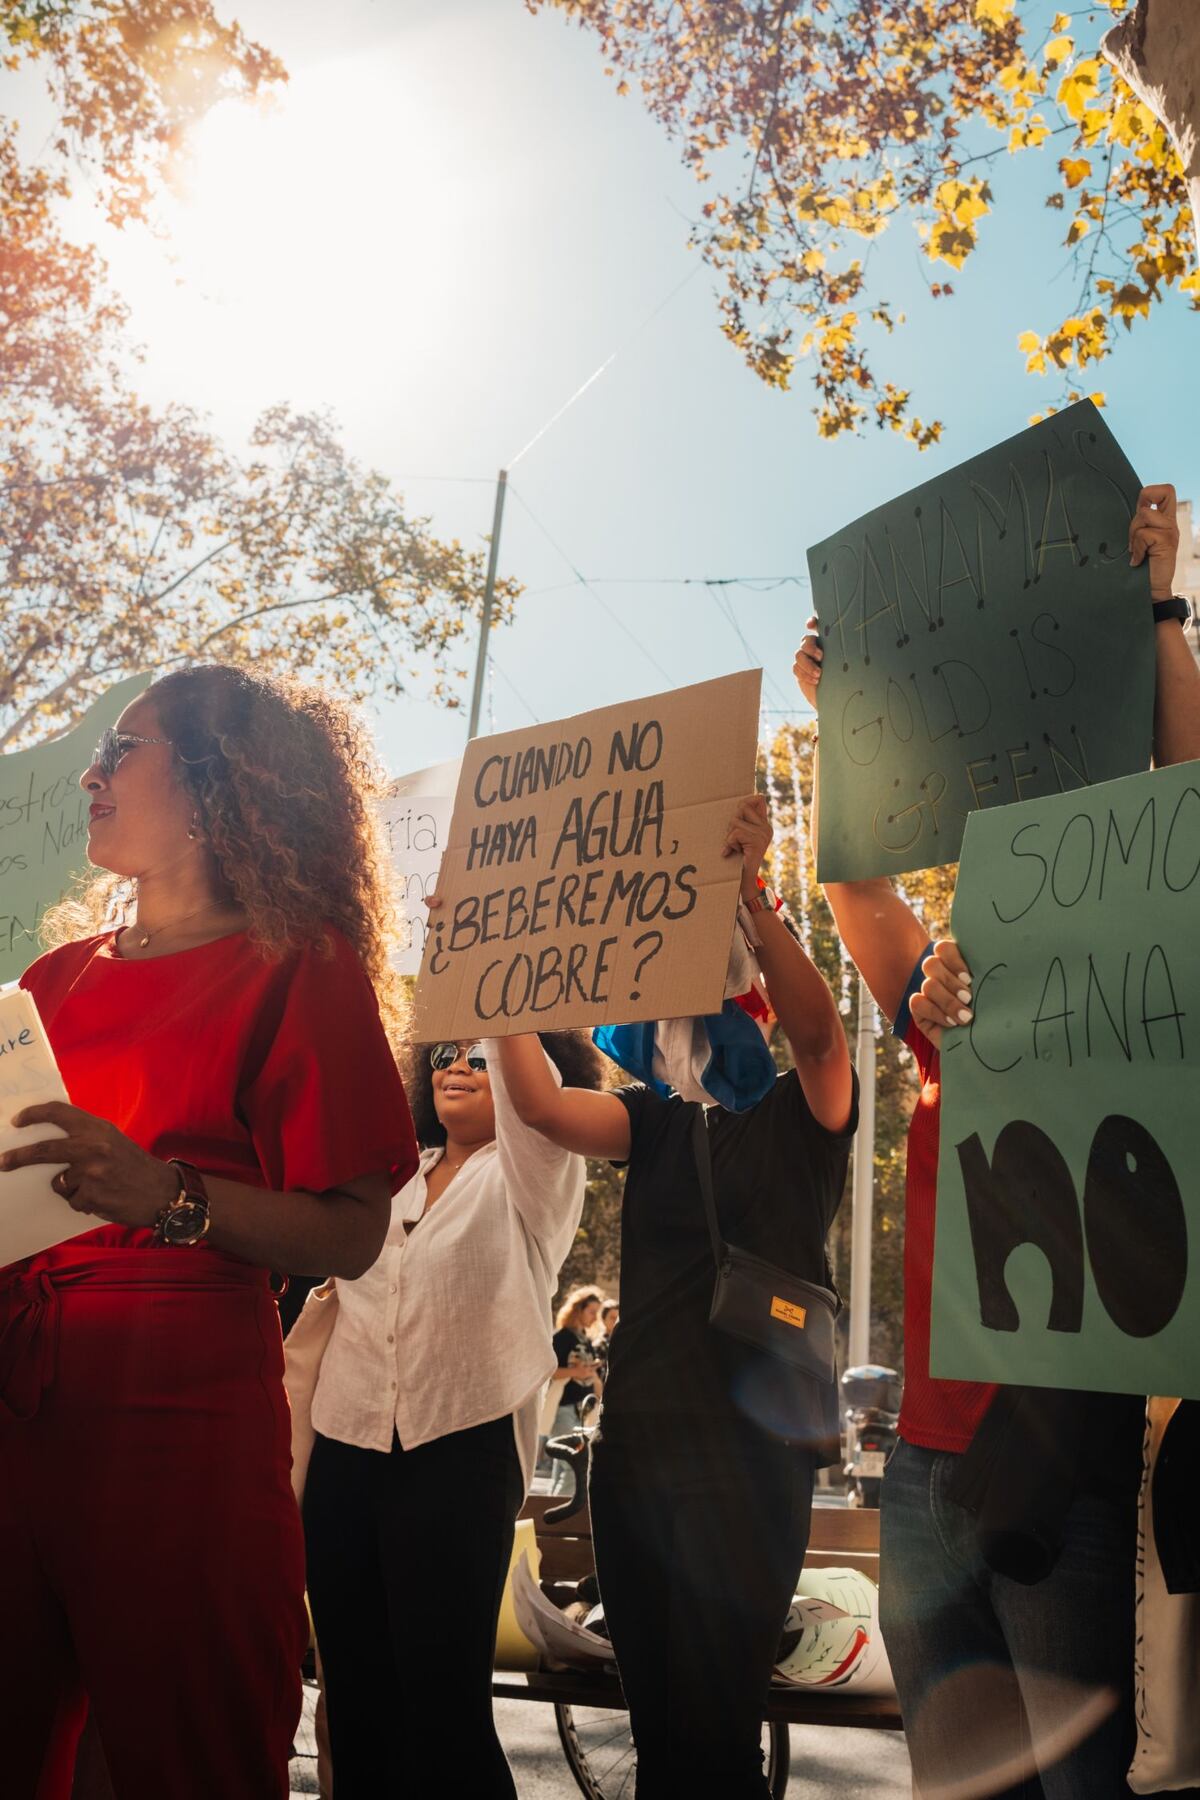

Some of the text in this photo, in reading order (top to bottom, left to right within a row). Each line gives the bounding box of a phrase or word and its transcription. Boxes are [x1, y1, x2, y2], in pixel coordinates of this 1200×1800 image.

[822, 429, 1134, 672] PANAMA'S
[842, 612, 1076, 766] GOLD IS
[466, 780, 679, 871] HAYA AGUA,
[474, 720, 663, 808] CUANDO NO
[873, 724, 1092, 853] GREEN
[992, 787, 1200, 923] SOMO
